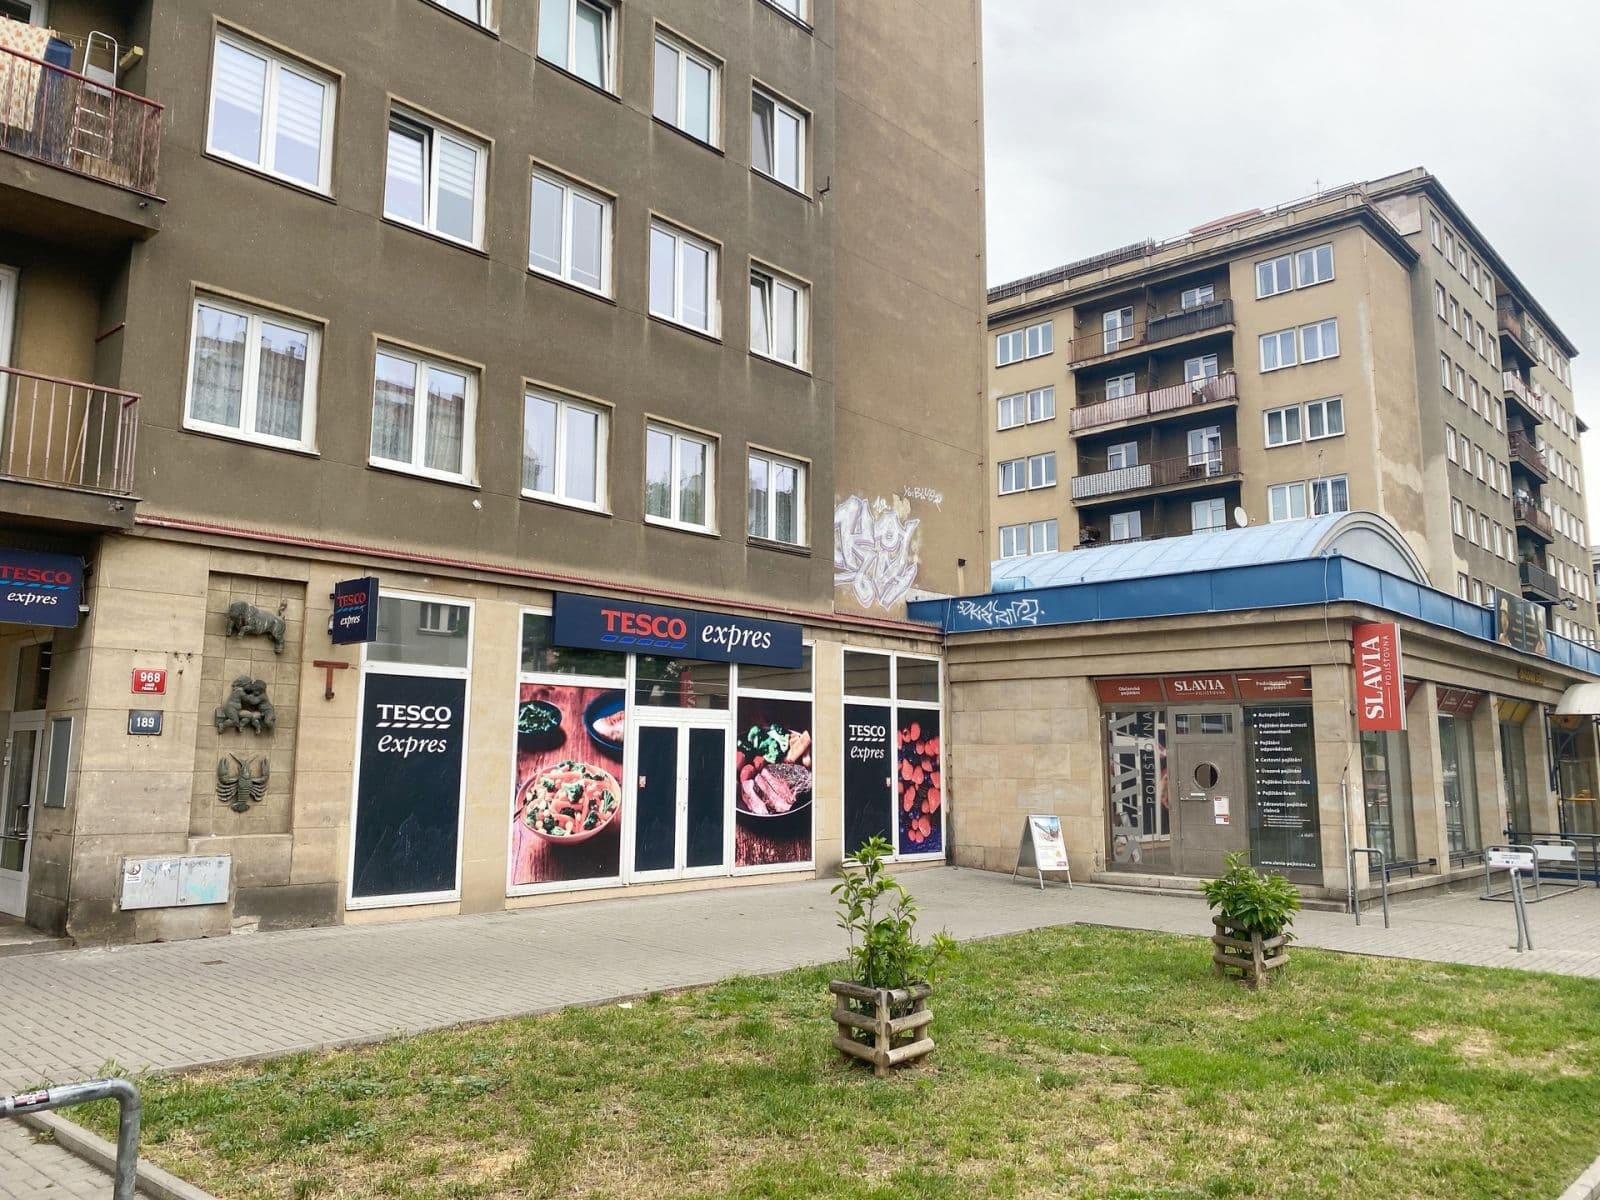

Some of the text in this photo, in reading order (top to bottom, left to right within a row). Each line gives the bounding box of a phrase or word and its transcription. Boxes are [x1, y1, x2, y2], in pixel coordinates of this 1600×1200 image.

[0, 565, 72, 584] TESCO
[7, 592, 58, 606] expres
[336, 592, 367, 608] TESCO
[340, 615, 361, 628] expres
[600, 609, 772, 653] TESCO expres
[140, 672, 161, 683] 968
[1174, 680, 1225, 692] SLAVIA
[1361, 635, 1385, 720] SLAVIA
[376, 703, 452, 722] TESCO
[137, 717, 155, 728] 189
[849, 724, 886, 737] TESCO
[377, 734, 447, 759] expres
[850, 745, 885, 763] expres
[1109, 712, 1142, 863] SLAVIA
